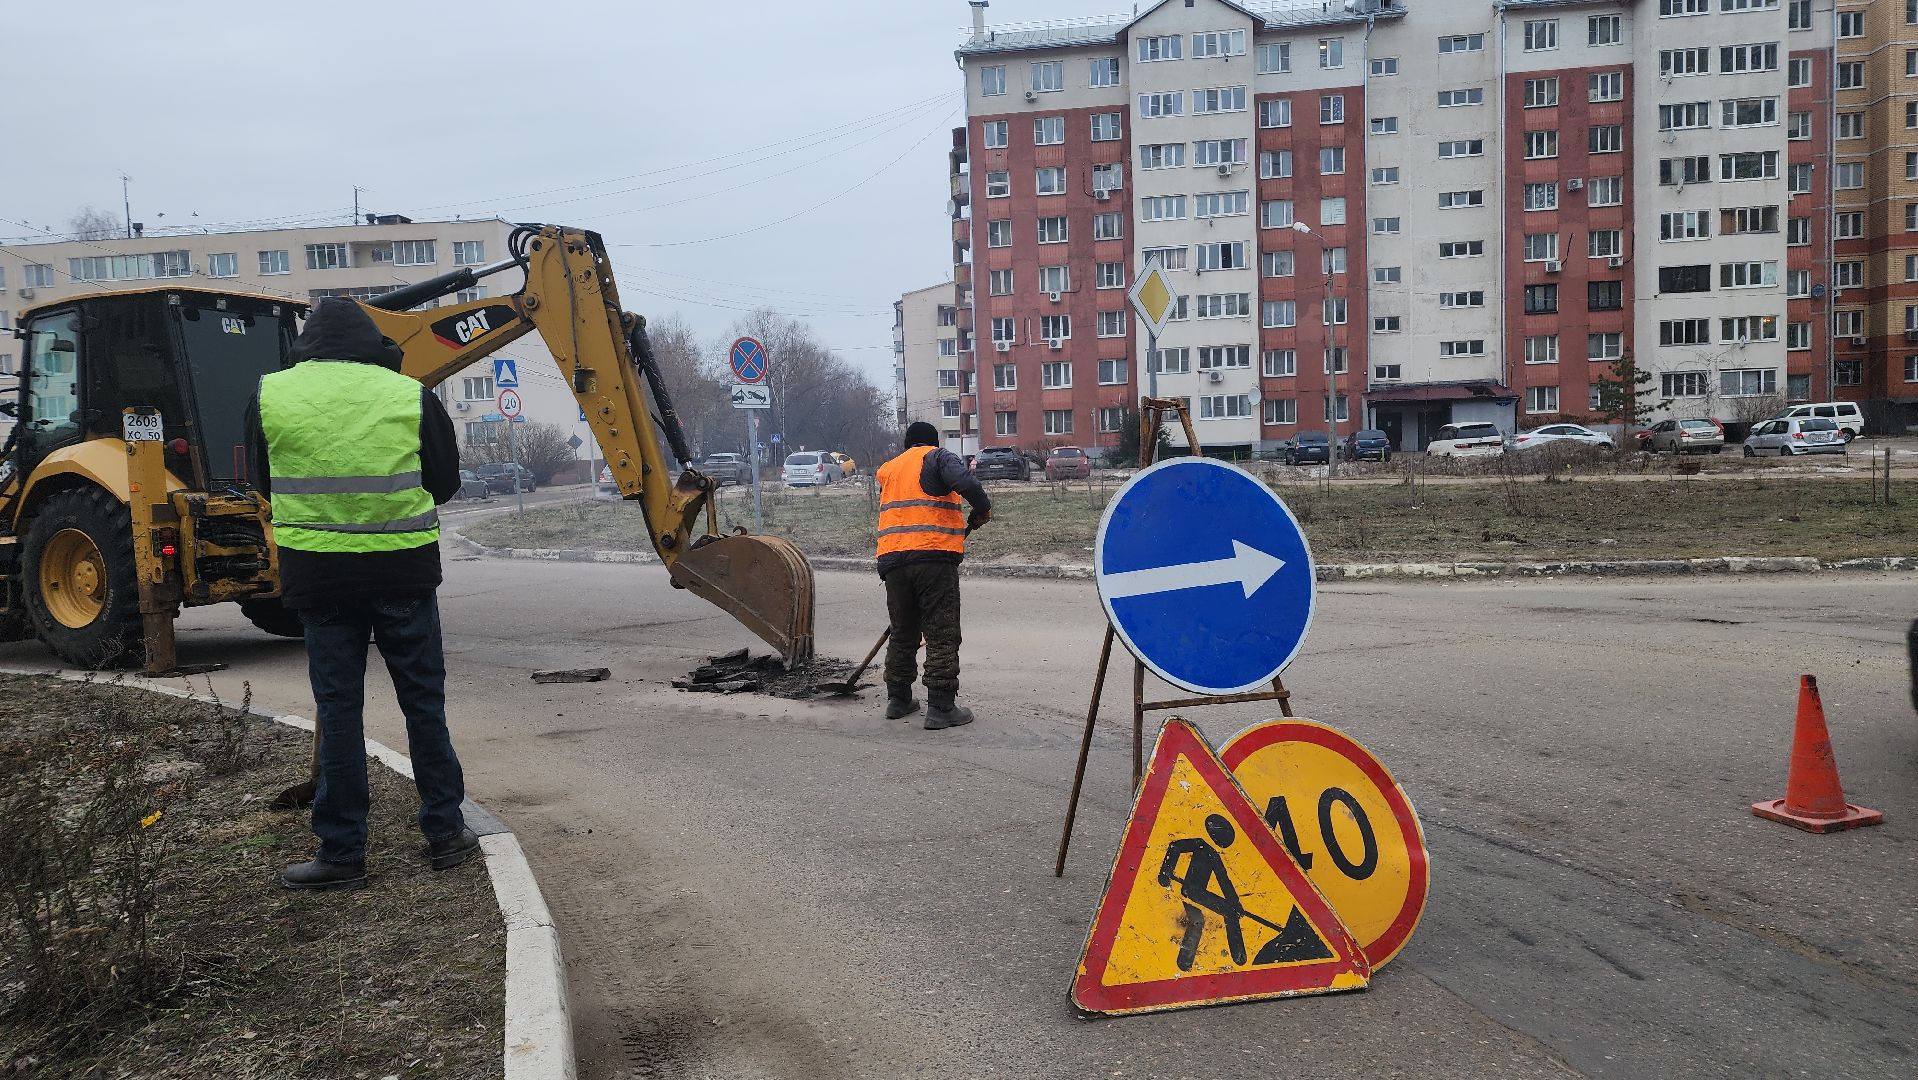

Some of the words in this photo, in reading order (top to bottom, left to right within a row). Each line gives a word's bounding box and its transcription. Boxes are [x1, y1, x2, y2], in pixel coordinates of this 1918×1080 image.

[221, 317, 246, 336] CAT
[456, 308, 491, 343] CAT
[504, 398, 517, 410] 20
[127, 415, 158, 428] 2608
[148, 431, 161, 440] 50
